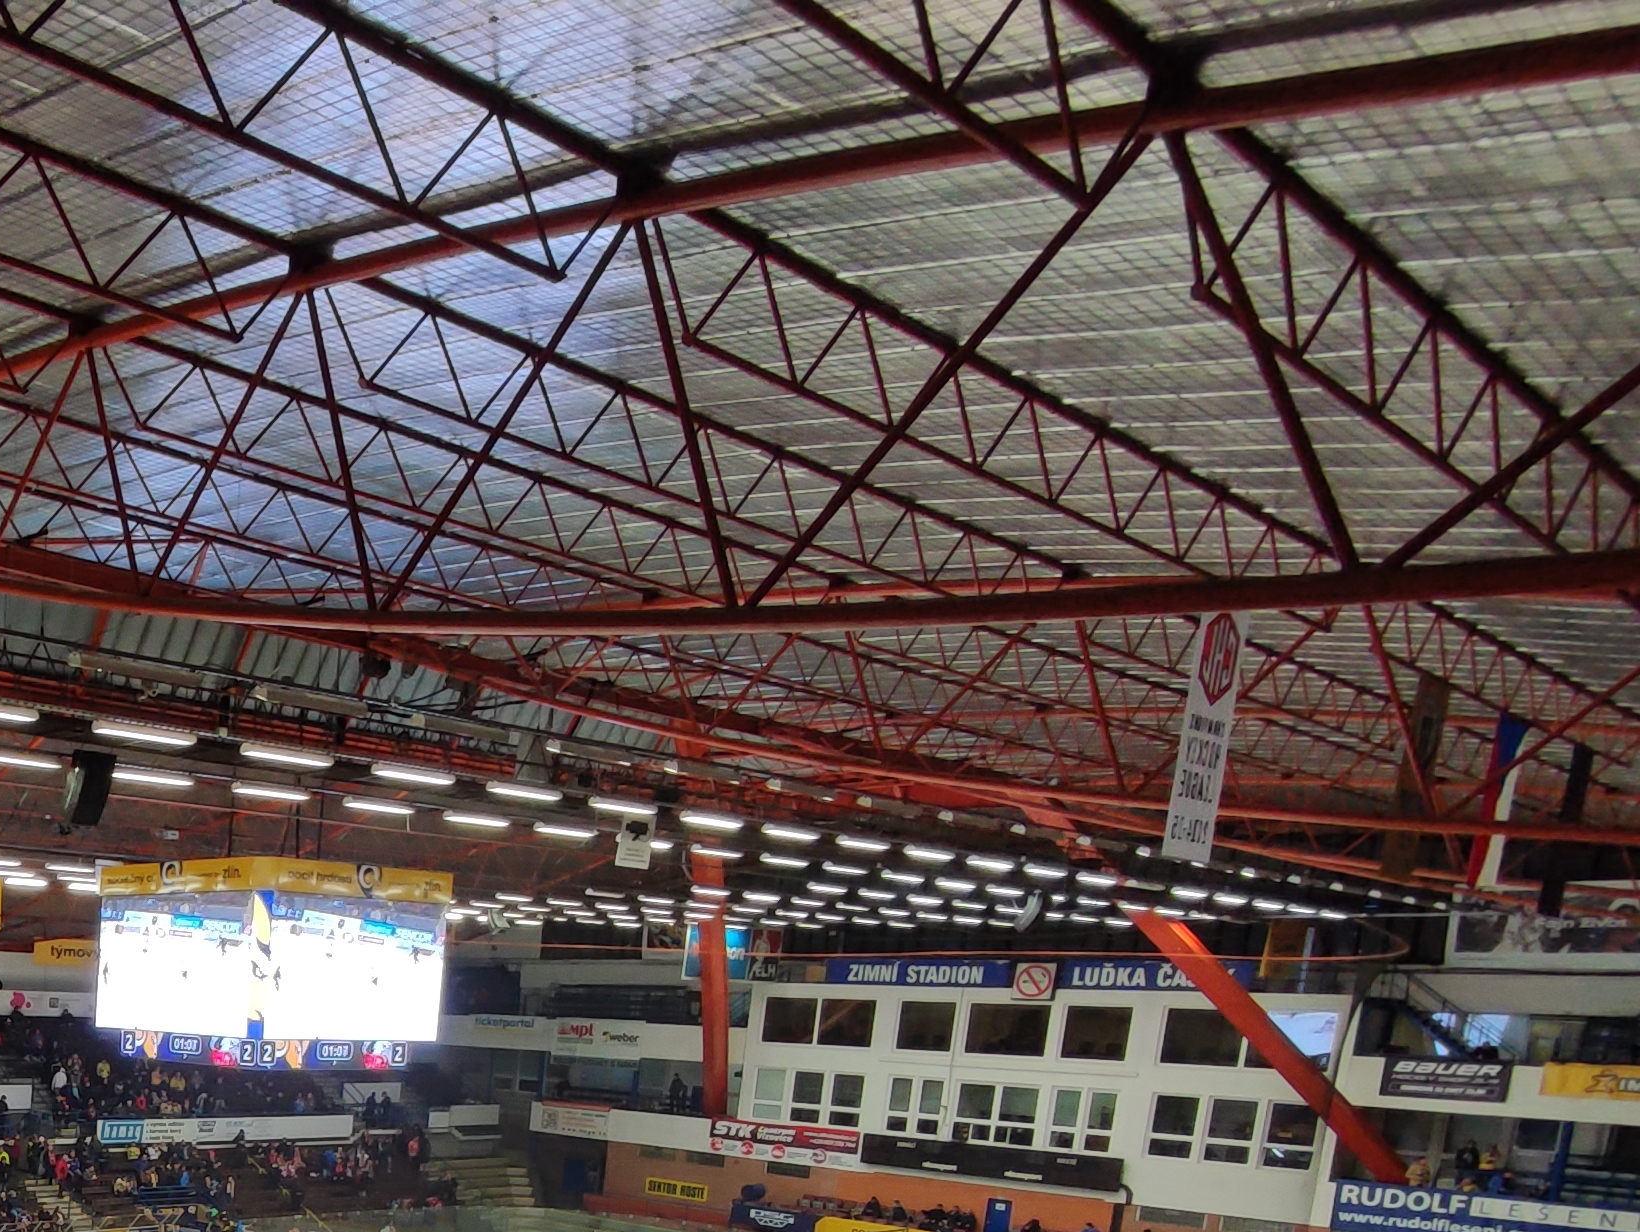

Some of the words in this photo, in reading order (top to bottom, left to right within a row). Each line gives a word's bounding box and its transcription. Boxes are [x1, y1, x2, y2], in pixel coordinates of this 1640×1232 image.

[847, 961, 899, 984] ZIMNÍ
[1071, 962, 1146, 988] LUĎKA
[124, 1034, 135, 1051] 2
[609, 1033, 640, 1043] weber
[242, 1045, 253, 1062] 2
[262, 1044, 274, 1062] 2
[394, 1045, 403, 1062] 2
[1392, 1061, 1503, 1077] BAUER
[713, 1121, 756, 1138] STK
[1339, 1184, 1468, 1215] RUDOLF
